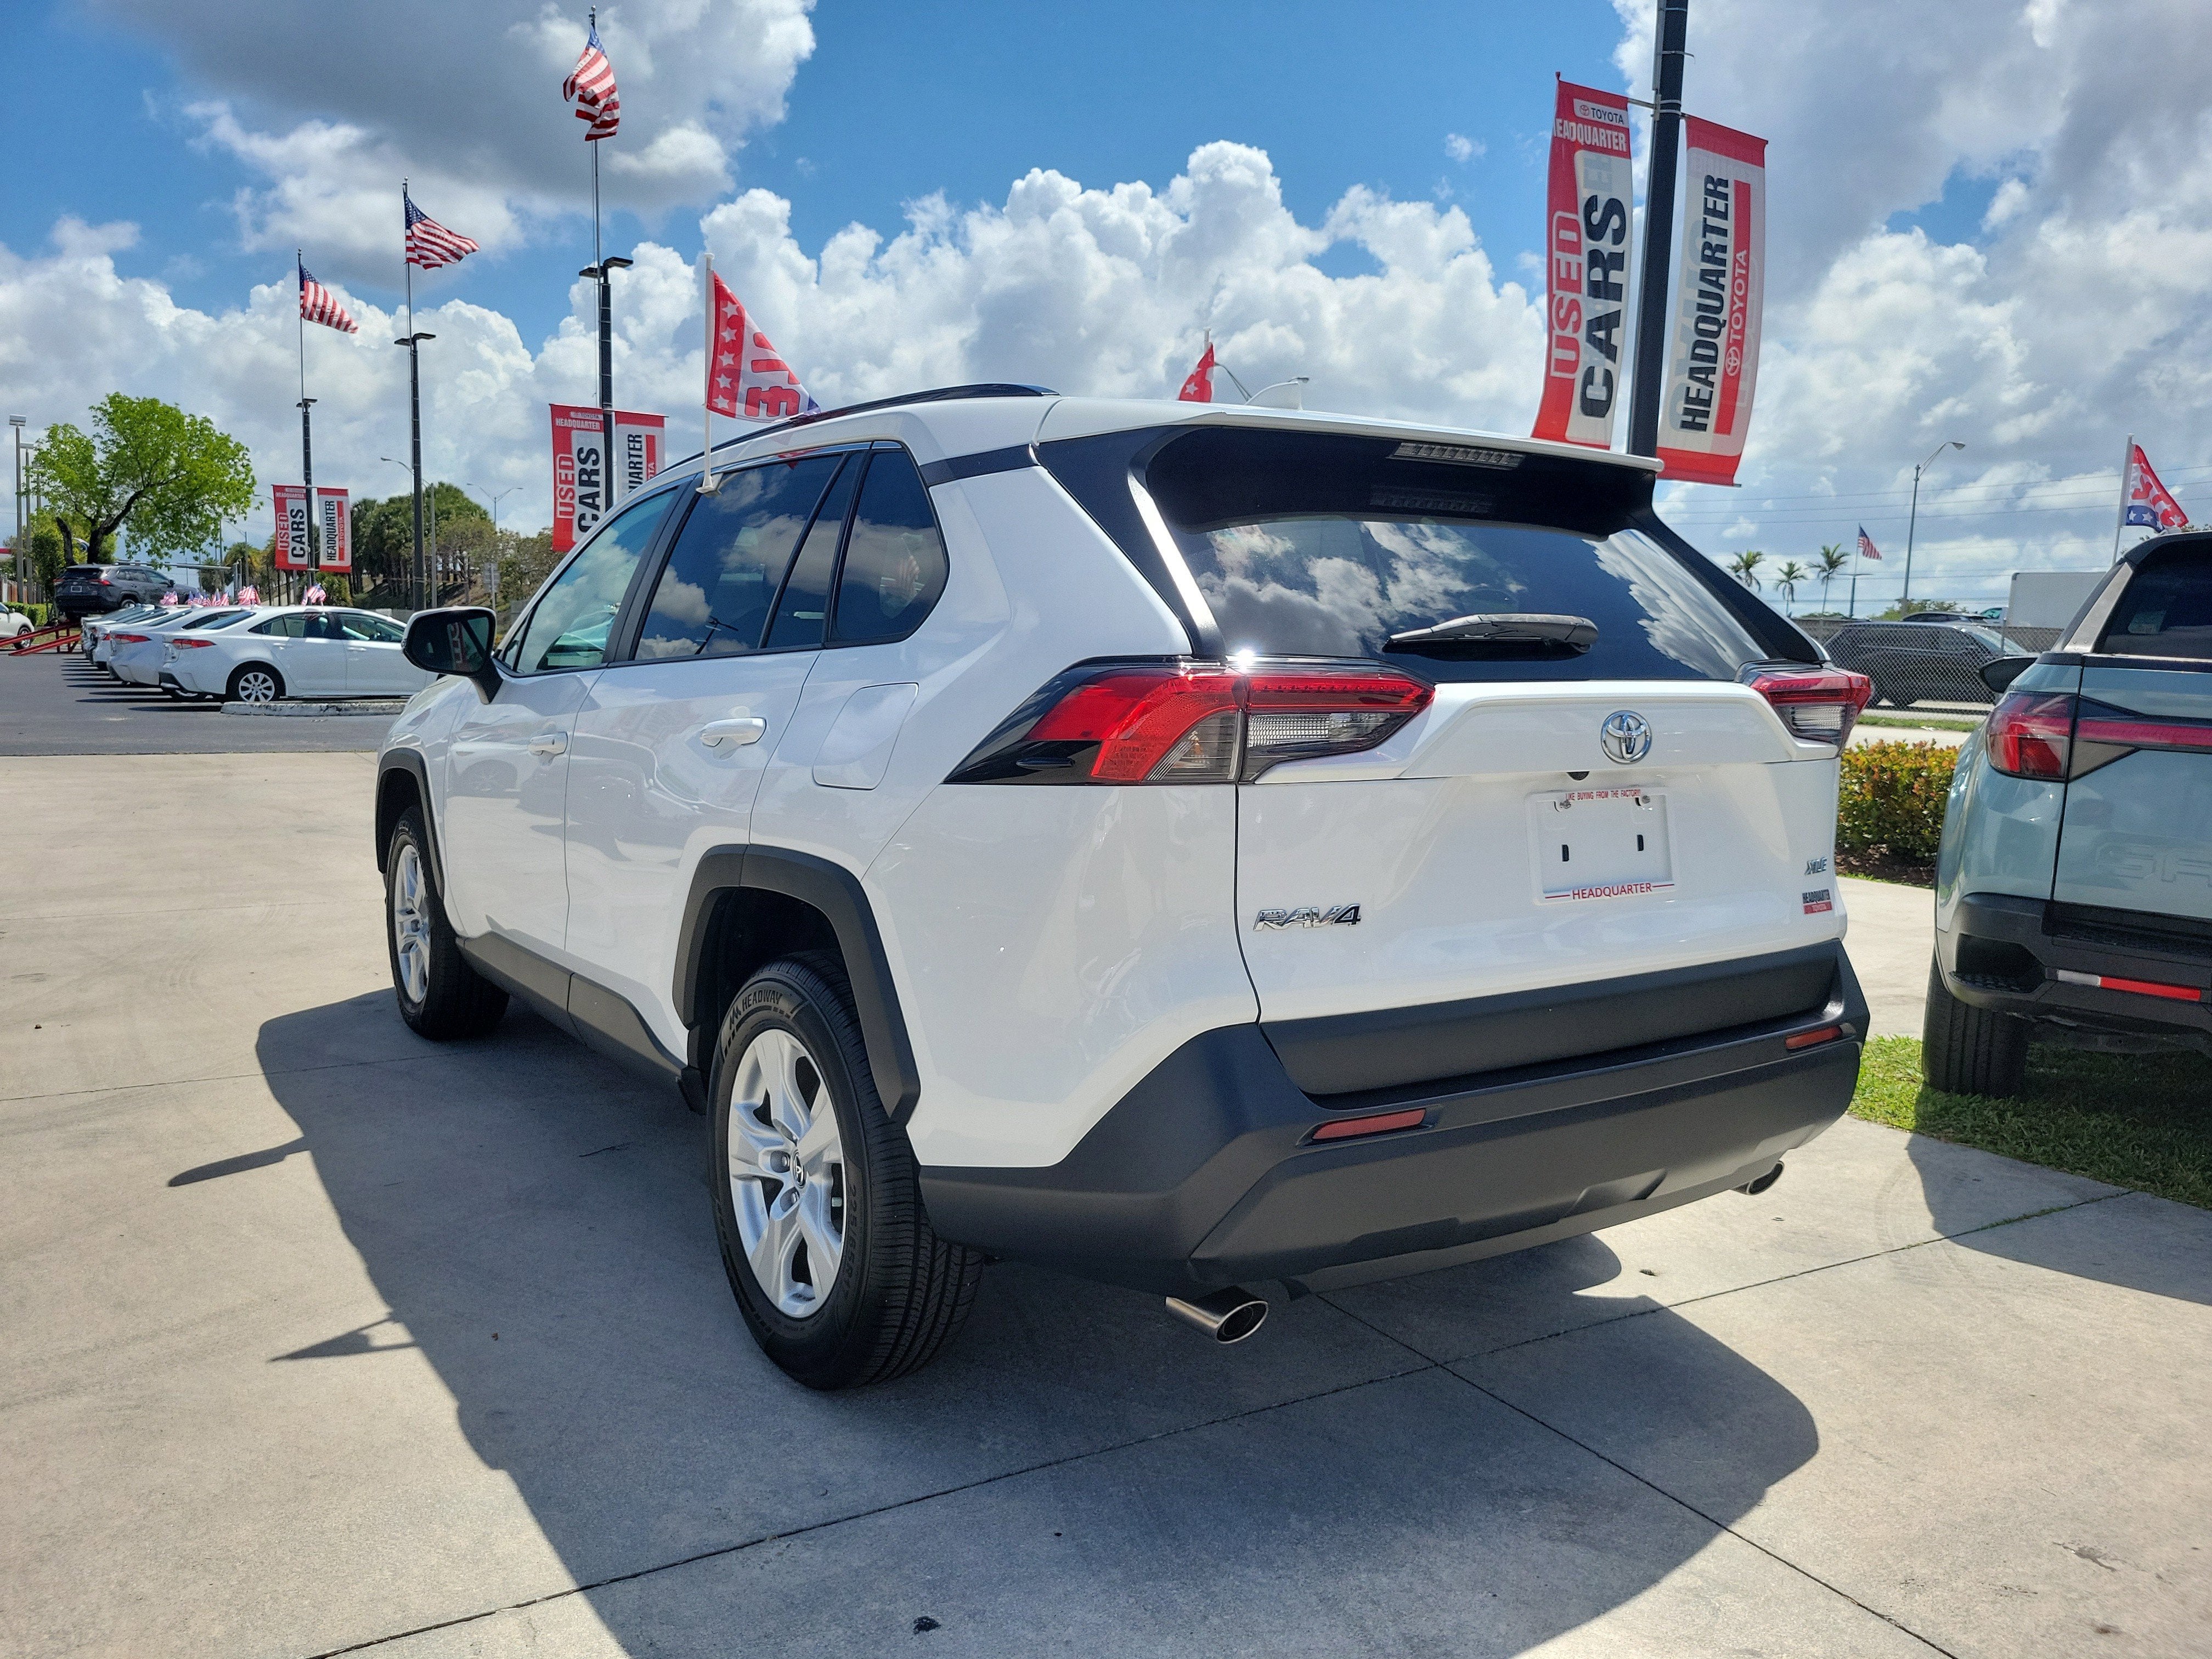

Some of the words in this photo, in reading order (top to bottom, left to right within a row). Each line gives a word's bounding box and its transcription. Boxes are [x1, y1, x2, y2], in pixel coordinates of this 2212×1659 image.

[1590, 108, 1624, 125] TOYOTA
[1550, 212, 1582, 379] USED
[1580, 195, 1626, 418] CARS
[1679, 174, 1729, 433] HEADQUARTER
[1729, 249, 1747, 344] TOYOTA
[555, 417, 600, 430] HEADQUARTER
[556, 453, 575, 518] USED
[628, 433, 643, 493] UARTER
[577, 447, 600, 533] CARS
[278, 512, 290, 550] USED
[290, 508, 306, 558] CARS
[325, 500, 338, 561] HEADQUARTER
[1577, 792, 1594, 800] BUYING
[1596, 791, 1609, 799] FROM
[1572, 882, 1652, 900] HEADQUARTER
[1804, 857, 1828, 875] XLE
[1253, 903, 1361, 932] RAV4
[741, 989, 783, 1011] HEADWAY
